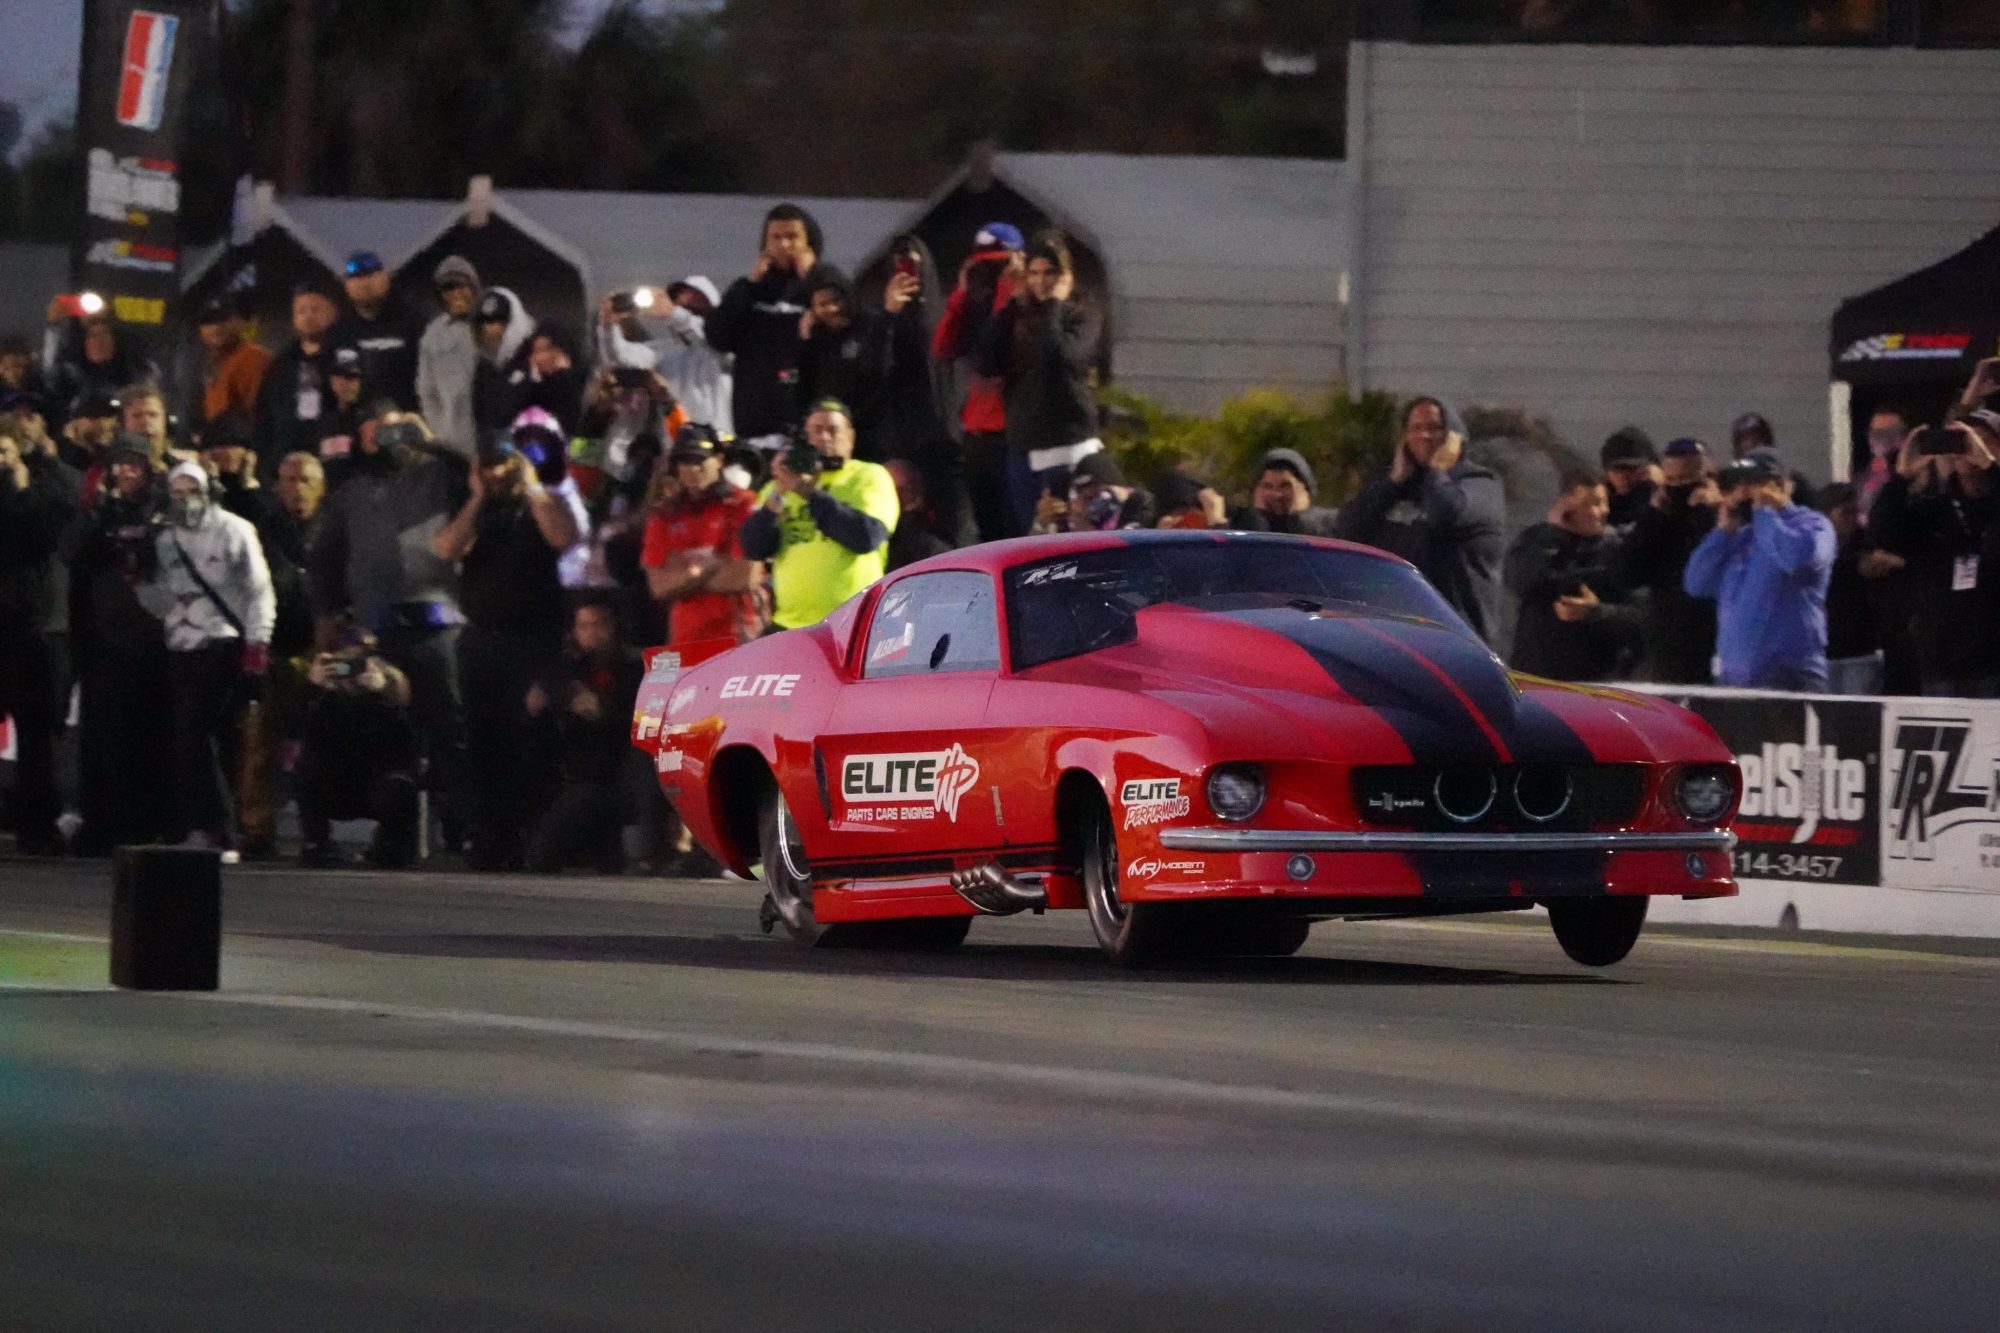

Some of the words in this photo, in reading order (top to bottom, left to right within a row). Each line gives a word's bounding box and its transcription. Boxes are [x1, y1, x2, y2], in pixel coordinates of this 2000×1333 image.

[719, 674, 801, 699] ELITE
[844, 759, 937, 794] ELITE
[1123, 783, 1178, 801] ELITE
[847, 808, 873, 821] PARTS
[875, 807, 898, 820] CARS
[900, 806, 935, 820] ENGINES
[1124, 796, 1189, 831] PERFORMANCE
[1730, 851, 1843, 878] 14-3457
